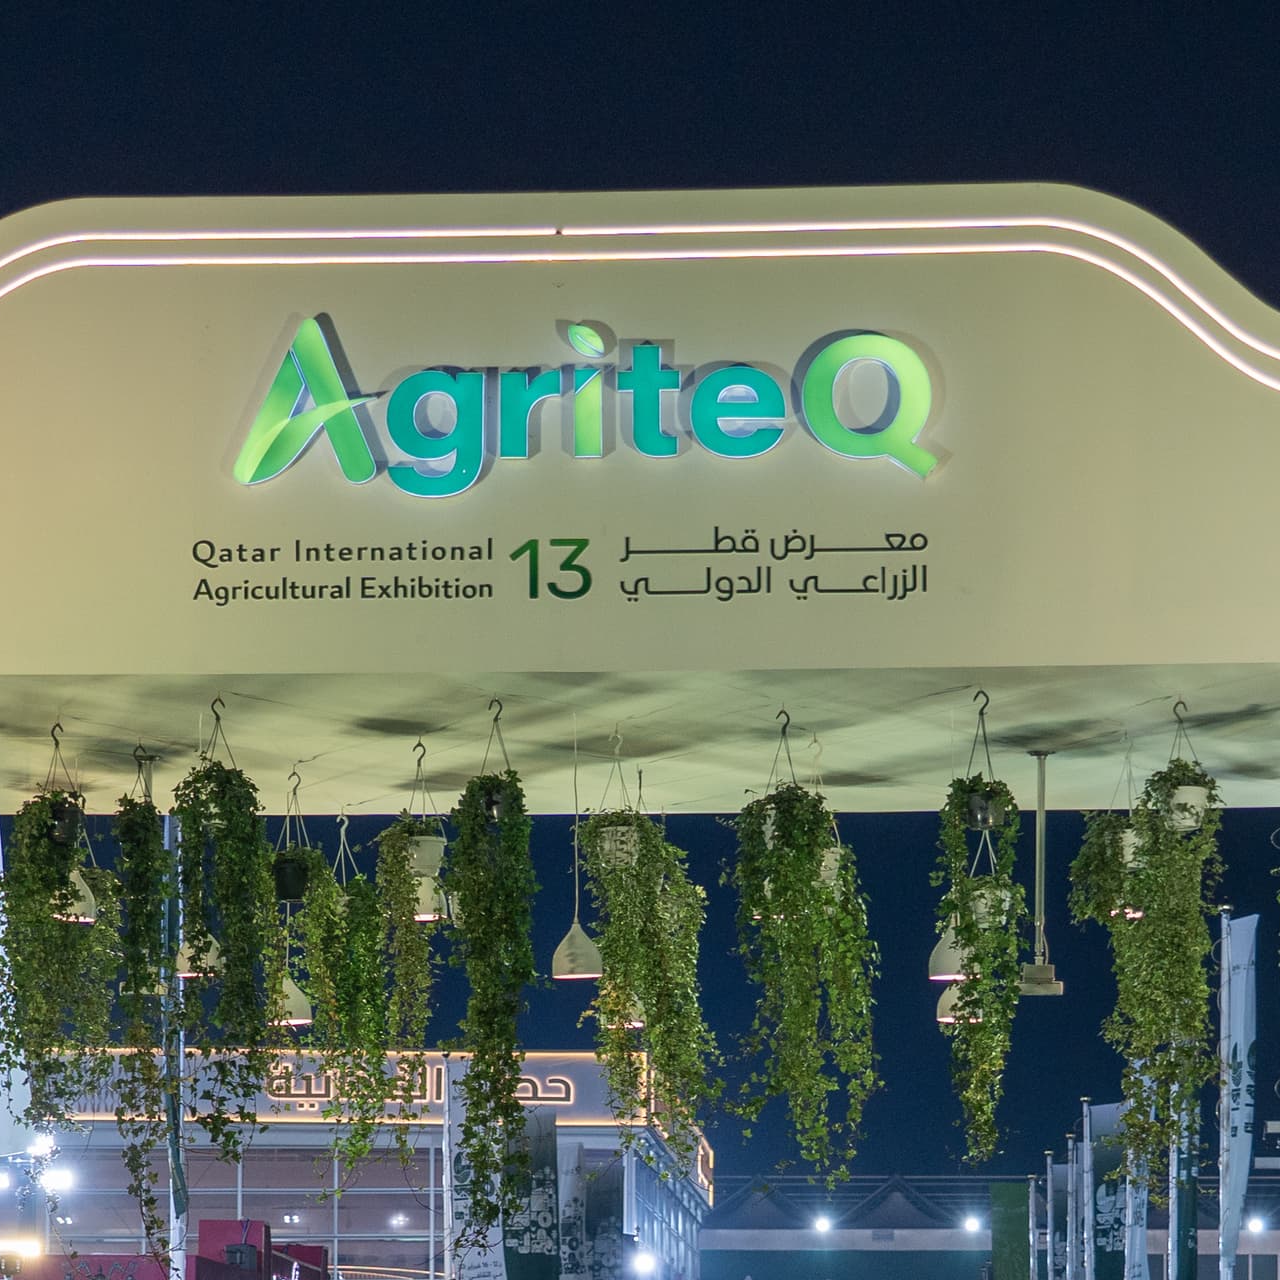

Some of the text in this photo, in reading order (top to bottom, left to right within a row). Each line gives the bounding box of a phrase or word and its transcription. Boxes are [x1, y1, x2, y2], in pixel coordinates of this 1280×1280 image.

[232, 317, 936, 498] AgriteQ
[192, 537, 493, 567] Qatar International
[509, 538, 593, 600] 13
[192, 575, 493, 606] Agricultural Exhibition
